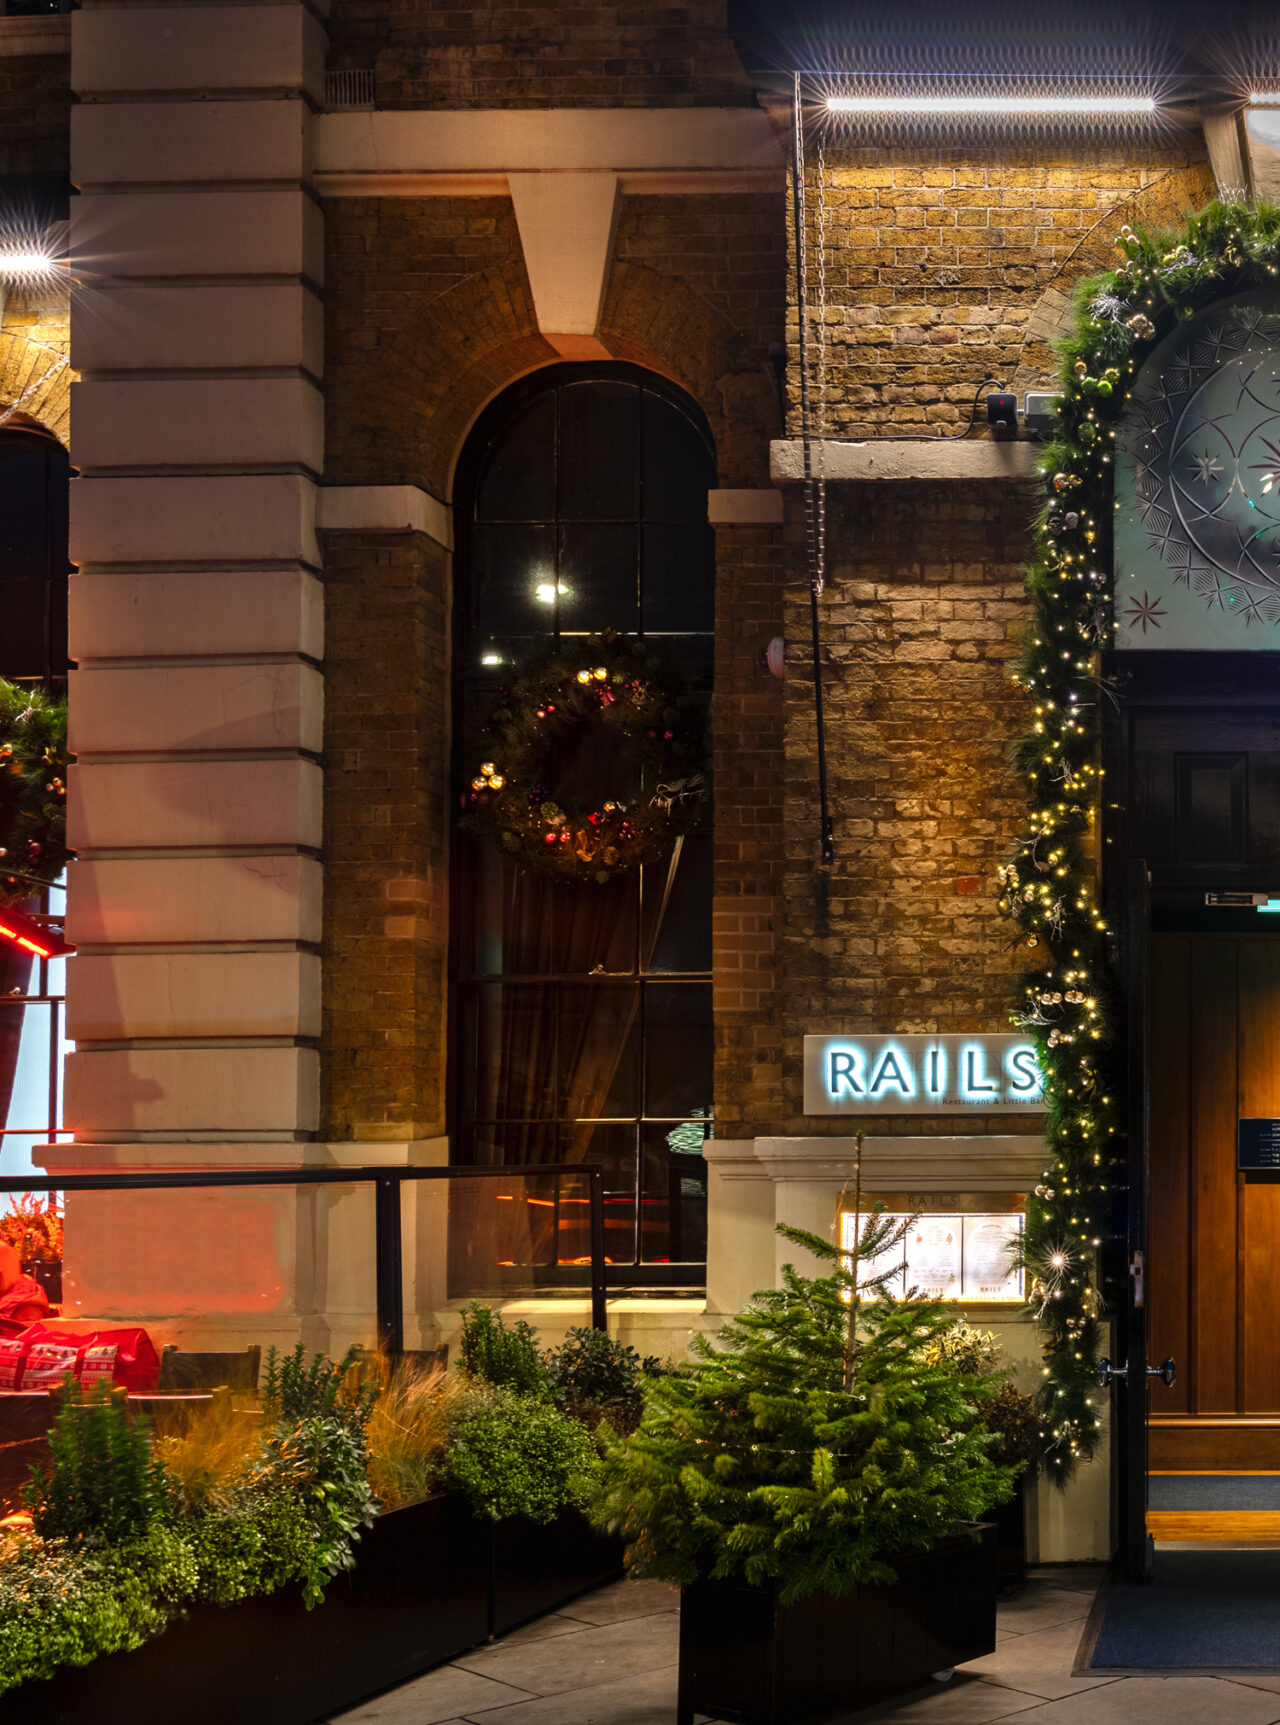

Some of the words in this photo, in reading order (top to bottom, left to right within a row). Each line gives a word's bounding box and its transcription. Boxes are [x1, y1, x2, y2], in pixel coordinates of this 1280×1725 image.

[830, 1050, 1037, 1093] RAILS
[942, 1097, 990, 1105] Restaurant
[1003, 1097, 1027, 1105] Little
[908, 1195, 958, 1206] RAILS
